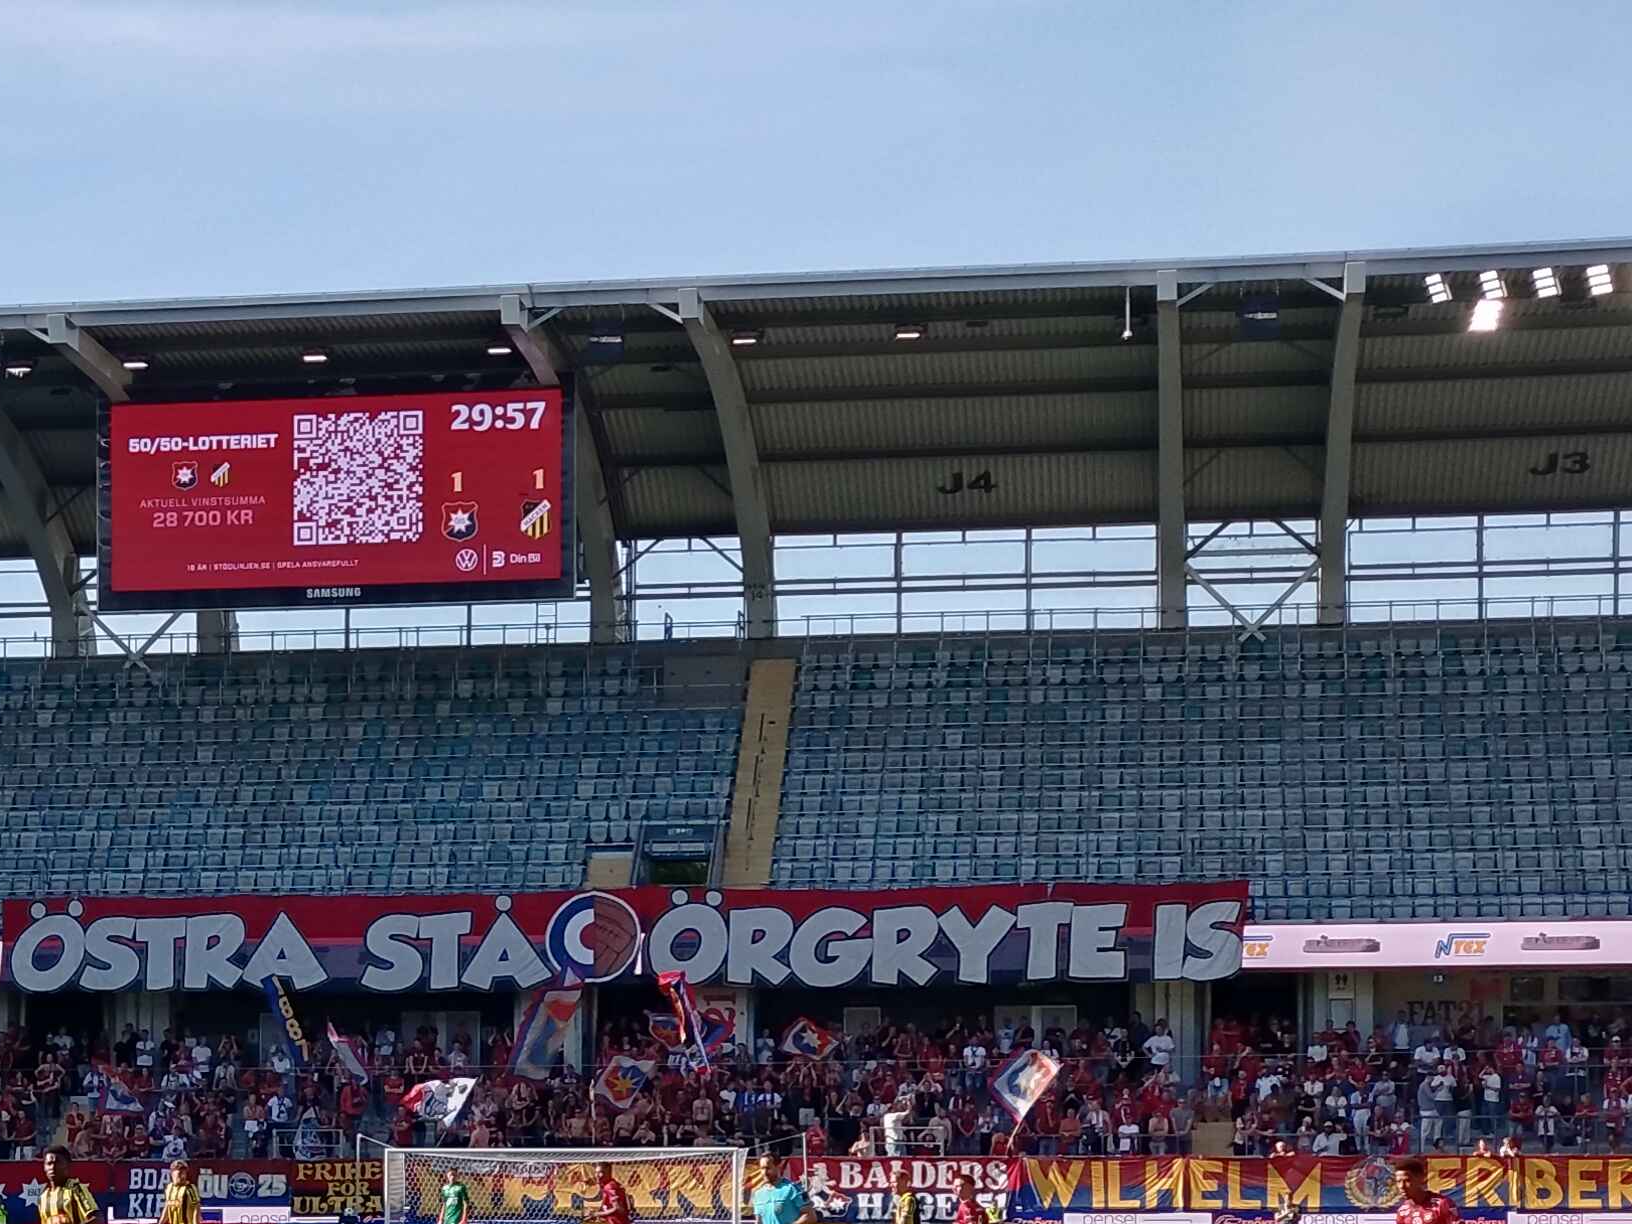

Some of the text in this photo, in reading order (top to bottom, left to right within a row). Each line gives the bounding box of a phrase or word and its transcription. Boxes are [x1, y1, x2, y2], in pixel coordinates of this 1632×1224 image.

[451, 401, 546, 431] 29:57
[128, 433, 279, 454] 50/50-LOTTERIET
[1529, 451, 1591, 476] J3
[451, 471, 462, 492] 1
[533, 468, 544, 489] 1
[936, 470, 997, 495] J4
[140, 496, 266, 509] AKTUELL VINSTSUMMA
[153, 510, 253, 528] 28 700 KR
[306, 587, 361, 598] SAMSUNG
[10, 888, 1242, 991] ÖSTRA STÅ ÖRGRYTE IS
[1023, 1157, 1321, 1210] WILHELM
